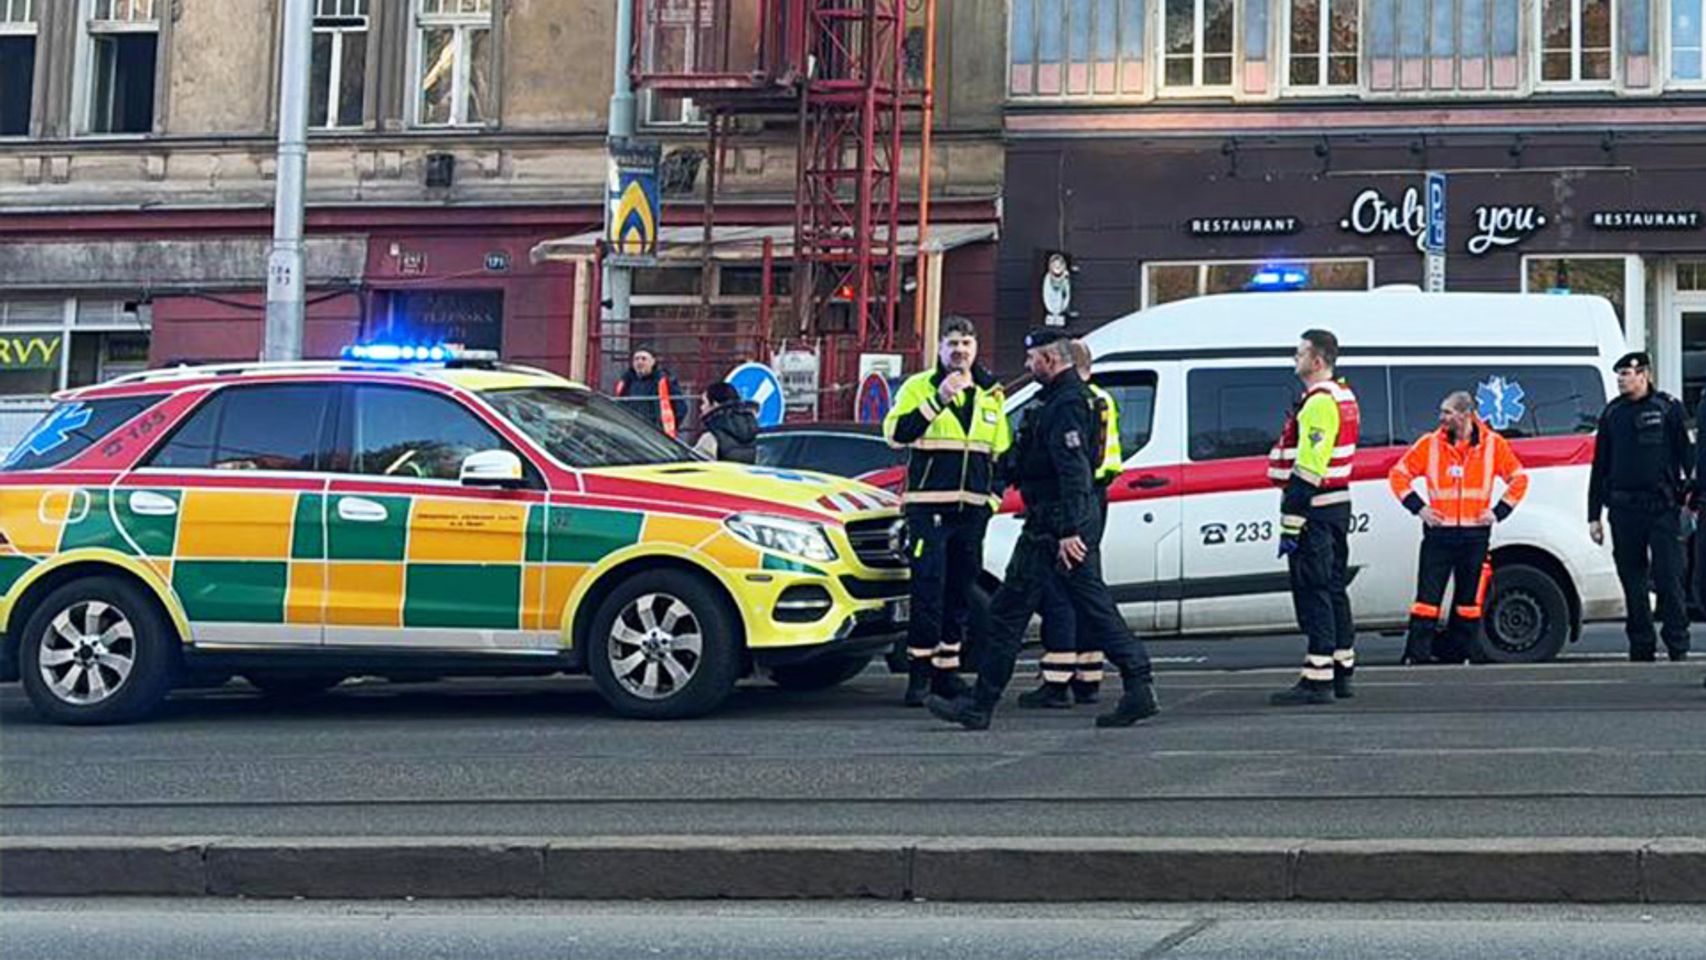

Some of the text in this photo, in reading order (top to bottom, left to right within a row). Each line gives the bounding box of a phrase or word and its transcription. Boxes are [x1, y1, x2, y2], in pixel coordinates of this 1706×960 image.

[1192, 218, 1296, 233] RESTAURANT
[1594, 212, 1698, 226] RESTAURANT
[1468, 206, 1535, 253] you
[1234, 520, 1273, 543] 233
